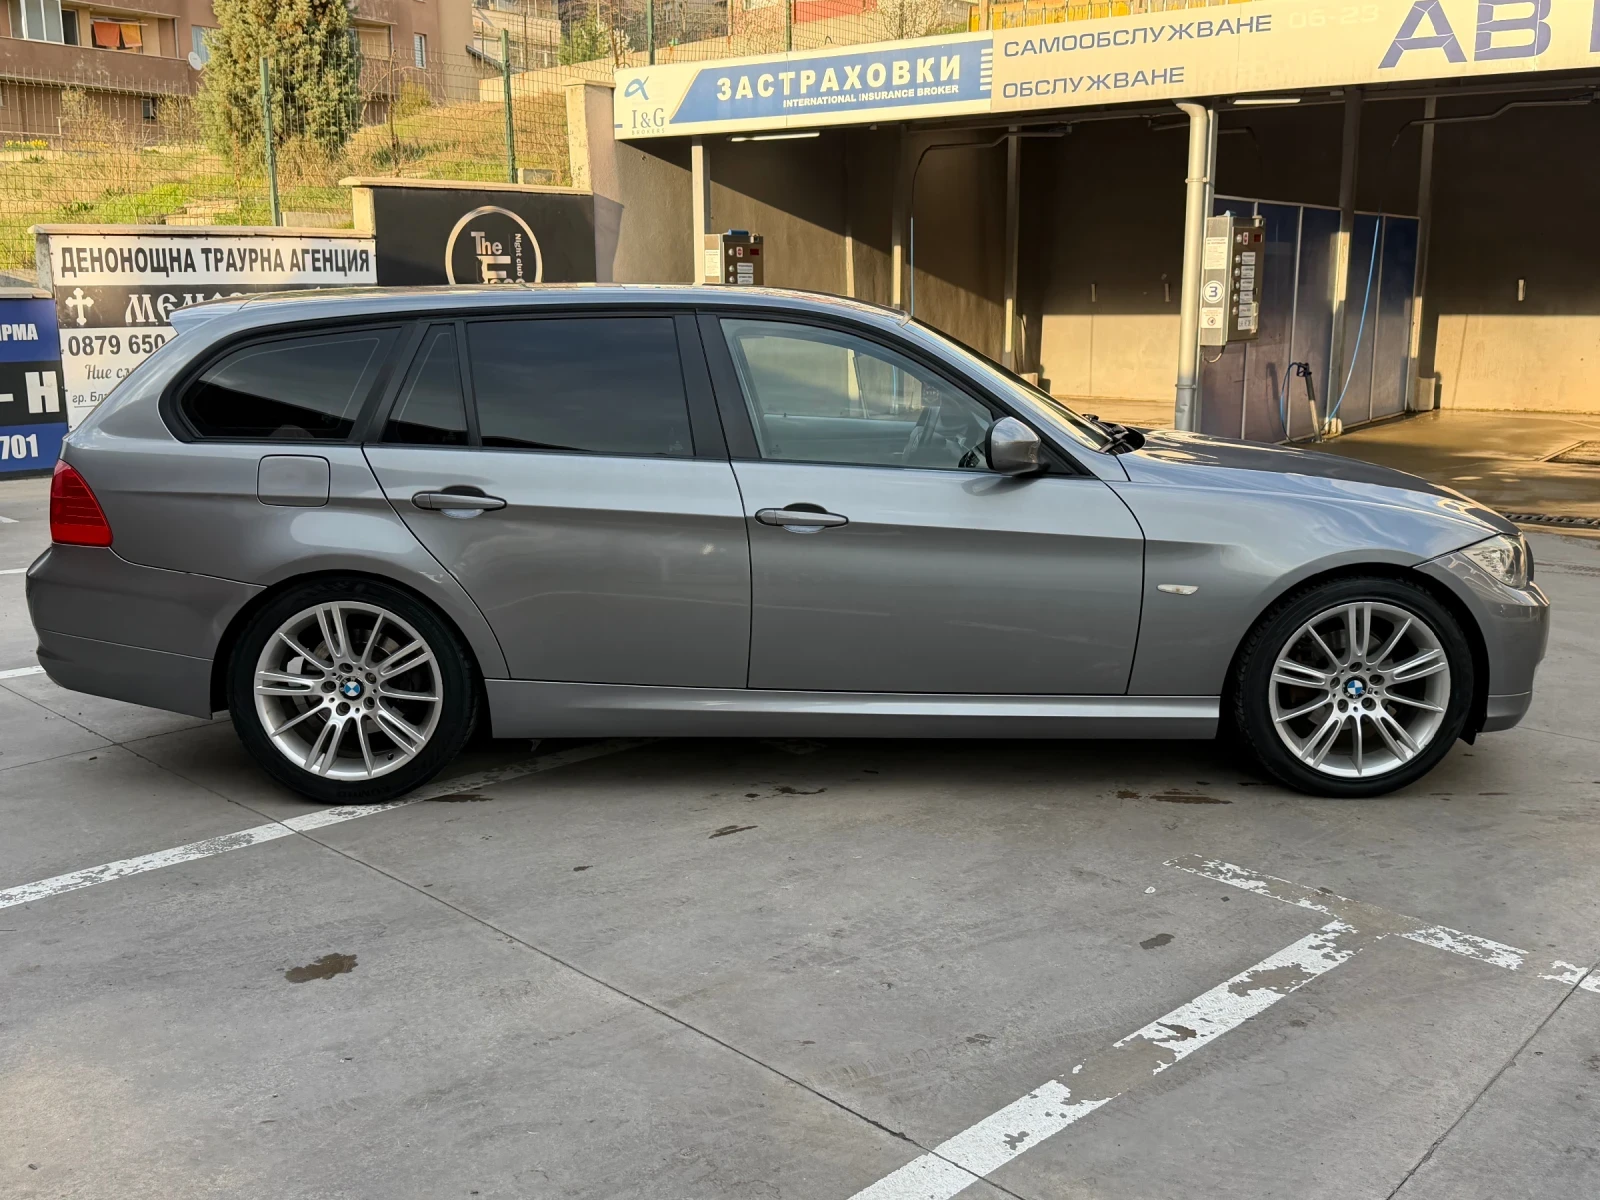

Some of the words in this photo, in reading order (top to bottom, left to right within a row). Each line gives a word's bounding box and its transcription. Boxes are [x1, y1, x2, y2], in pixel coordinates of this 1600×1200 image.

[1004, 14, 1272, 57] САМООБСЛУЖВАНЕ
[1378, 0, 1600, 69] АВ
[716, 54, 961, 101] ЗАСТРАХОВКИ
[1003, 66, 1185, 98] ОБСЛУЖВАНЕ
[783, 93, 857, 108] INTERNATIONAL
[859, 88, 915, 102] INSURANCE
[916, 84, 959, 97] BROKER
[470, 231, 503, 255] The
[513, 233, 523, 257] Night
[61, 247, 197, 278] ДЕНОНОЩНА
[201, 247, 285, 273] ТРАУРНА
[289, 248, 370, 277] АГЕНЦИЯ
[516, 258, 524, 277] club
[1208, 286, 1218, 298] 3
[0, 323, 39, 341] РМА
[68, 335, 121, 357] 0879
[84, 364, 112, 380] Ние
